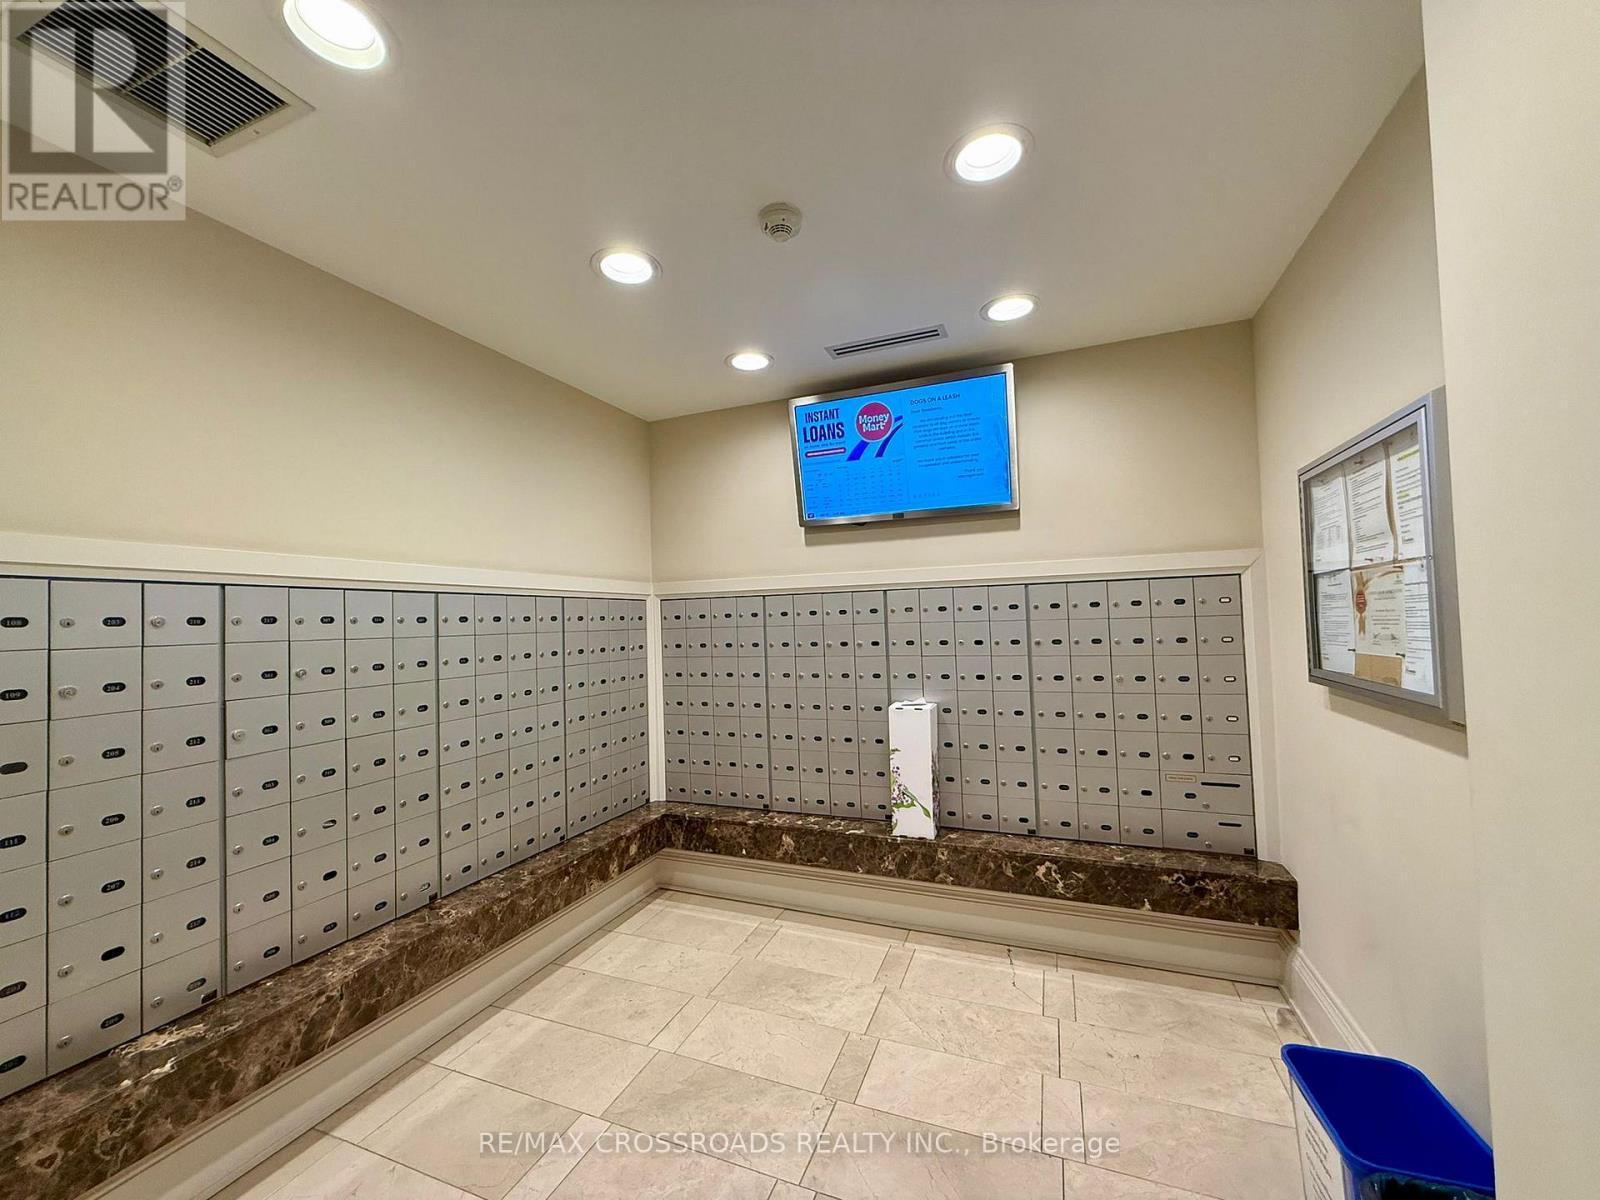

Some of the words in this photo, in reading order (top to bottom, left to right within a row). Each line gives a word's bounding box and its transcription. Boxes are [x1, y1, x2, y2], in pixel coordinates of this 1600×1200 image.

[805, 408, 840, 424] INSTANT
[859, 413, 889, 424] Money
[803, 422, 845, 443] LOANS
[862, 422, 886, 432] Mart
